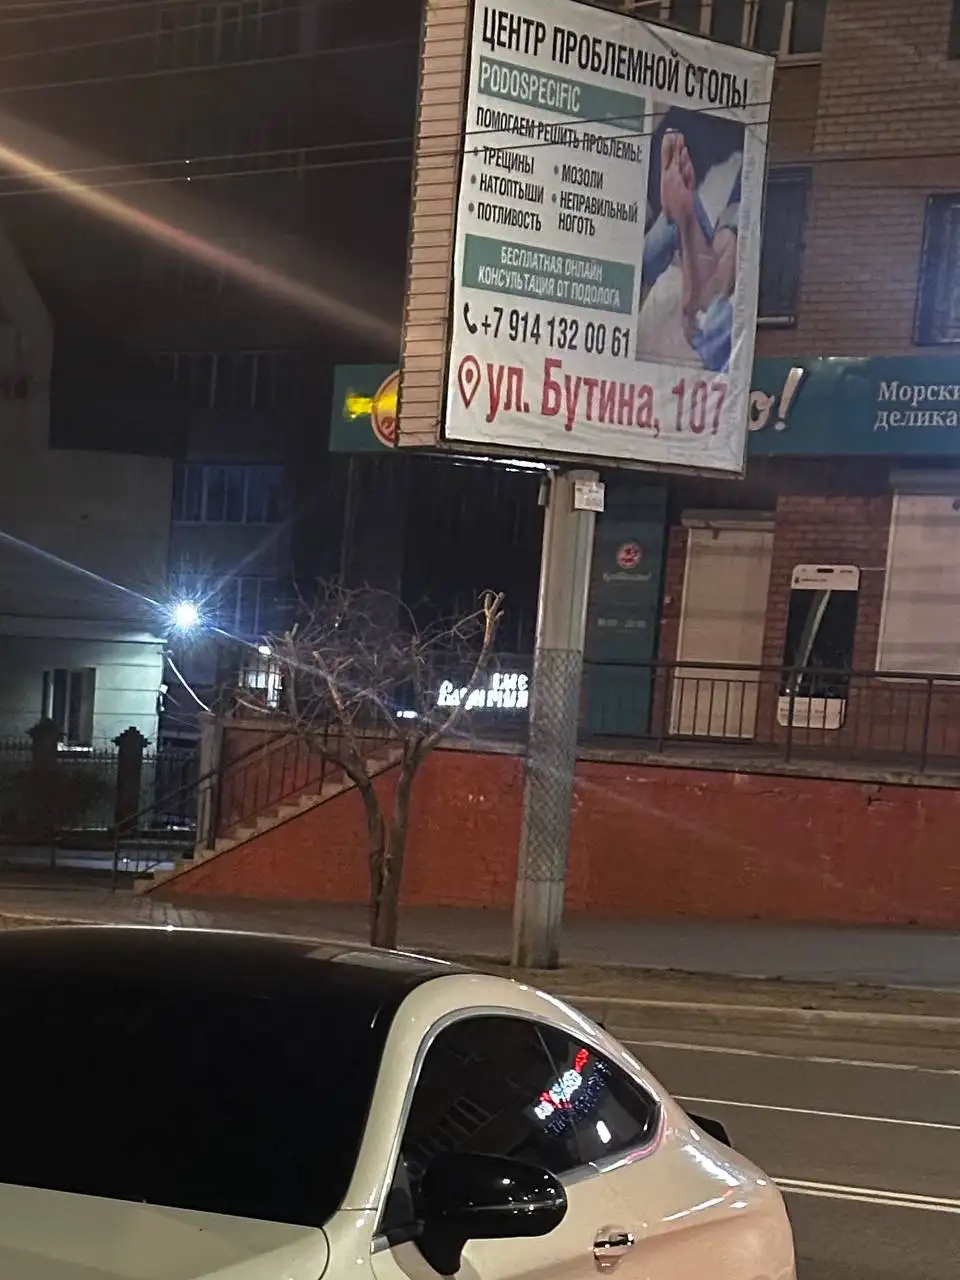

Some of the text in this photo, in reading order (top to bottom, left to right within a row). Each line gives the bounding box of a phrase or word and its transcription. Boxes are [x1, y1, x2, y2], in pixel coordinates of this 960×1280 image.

[482, 7, 748, 109] ЦЕНТР ПРОБЛЕМНОЙ СТОПЫ
[479, 61, 581, 113] PODOSPECIFIC
[476, 106, 535, 138] ПОМОГАЕМ
[537, 121, 580, 149] РЕШИТЬ
[482, 146, 534, 175] ТРЕЩИНЫ
[561, 163, 604, 190] МОЗОЛИ
[479, 175, 544, 204] НАТОПТЫШИ
[477, 201, 542, 232] ПОТЛИВОСТЬ
[559, 191, 639, 224] НЕПРАВИЛЬНЫЙ
[558, 216, 596, 236] НОГОТЬ
[501, 246, 603, 282] БЕСПЛАТНАЯ ОНЛАЙН
[478, 265, 620, 307] КОНСУЛЬТАЦИЯ ОТ ПОДОЛОГА
[481, 307, 631, 358] +7 914 132 00 61
[486, 357, 728, 438] ул. Бутина, 107
[874, 410, 960, 432] делика
